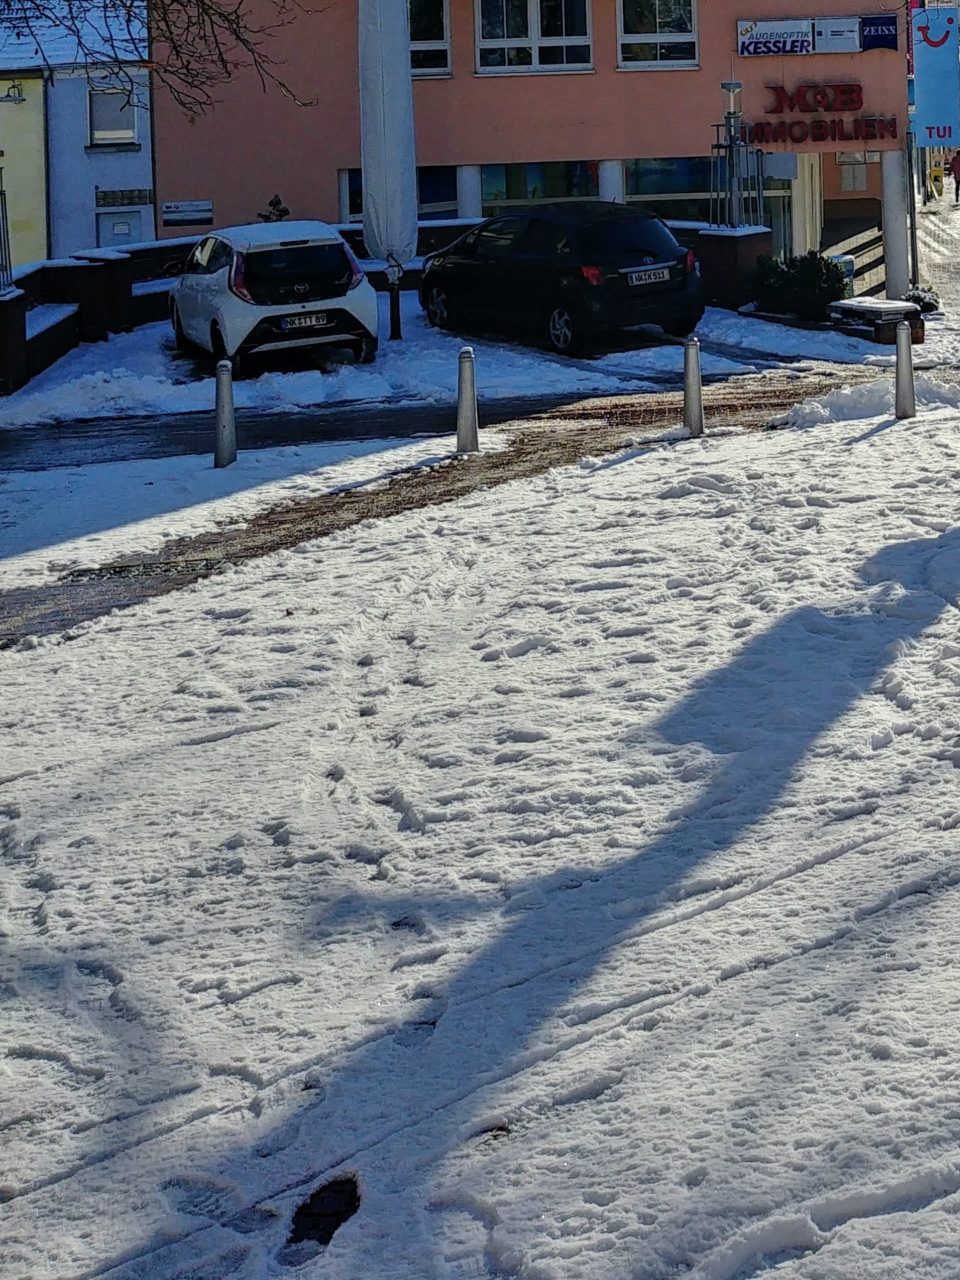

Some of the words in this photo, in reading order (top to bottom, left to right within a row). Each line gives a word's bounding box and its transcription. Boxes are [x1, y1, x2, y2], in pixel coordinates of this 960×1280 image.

[748, 30, 810, 40] AUGENOPTIK
[863, 25, 896, 35] ZEISS
[740, 39, 811, 55] KESSLER
[926, 126, 952, 138] TUI
